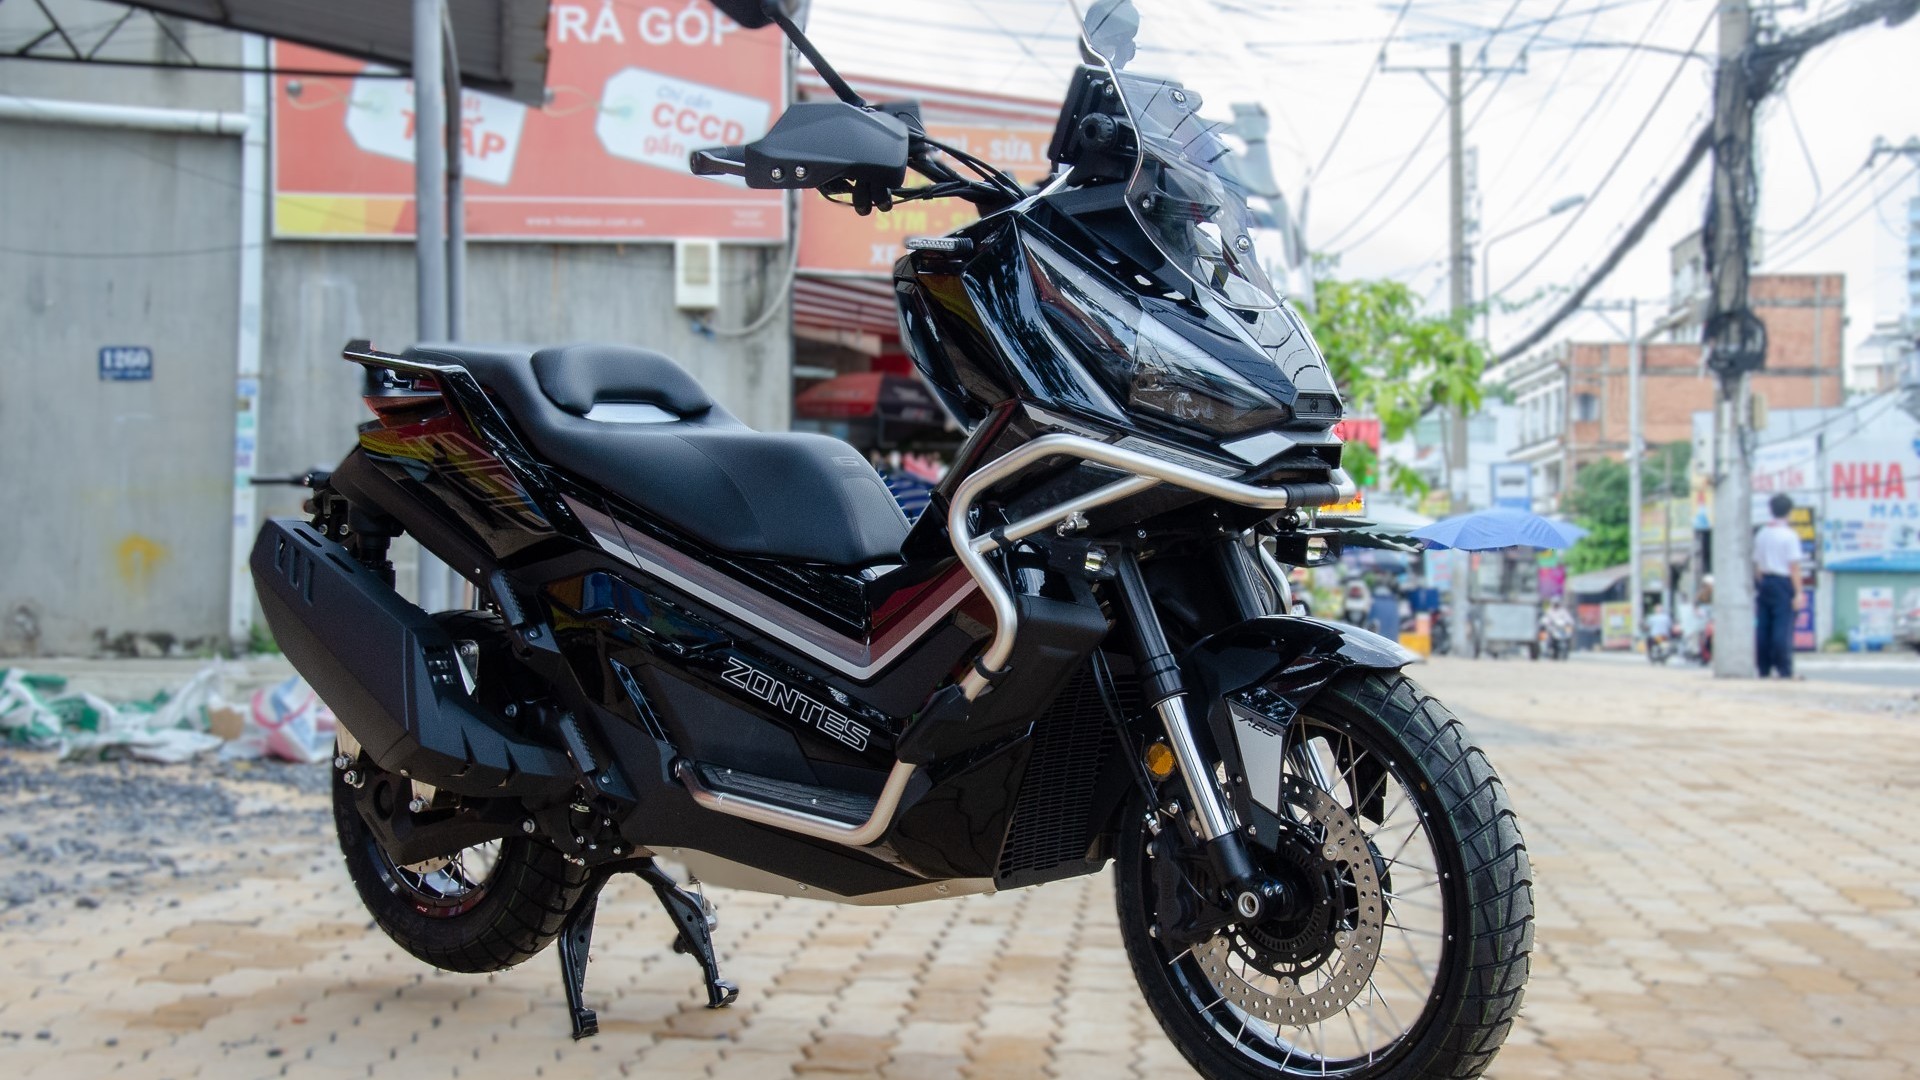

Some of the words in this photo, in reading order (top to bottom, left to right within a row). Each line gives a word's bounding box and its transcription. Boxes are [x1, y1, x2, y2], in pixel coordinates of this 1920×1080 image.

[637, 0, 740, 46] GÓP
[651, 102, 745, 146] CCCD
[874, 211, 928, 232] SYM
[1832, 462, 1906, 499] NHA
[721, 656, 871, 752] ZONTES
[1238, 717, 1280, 738] ABS
